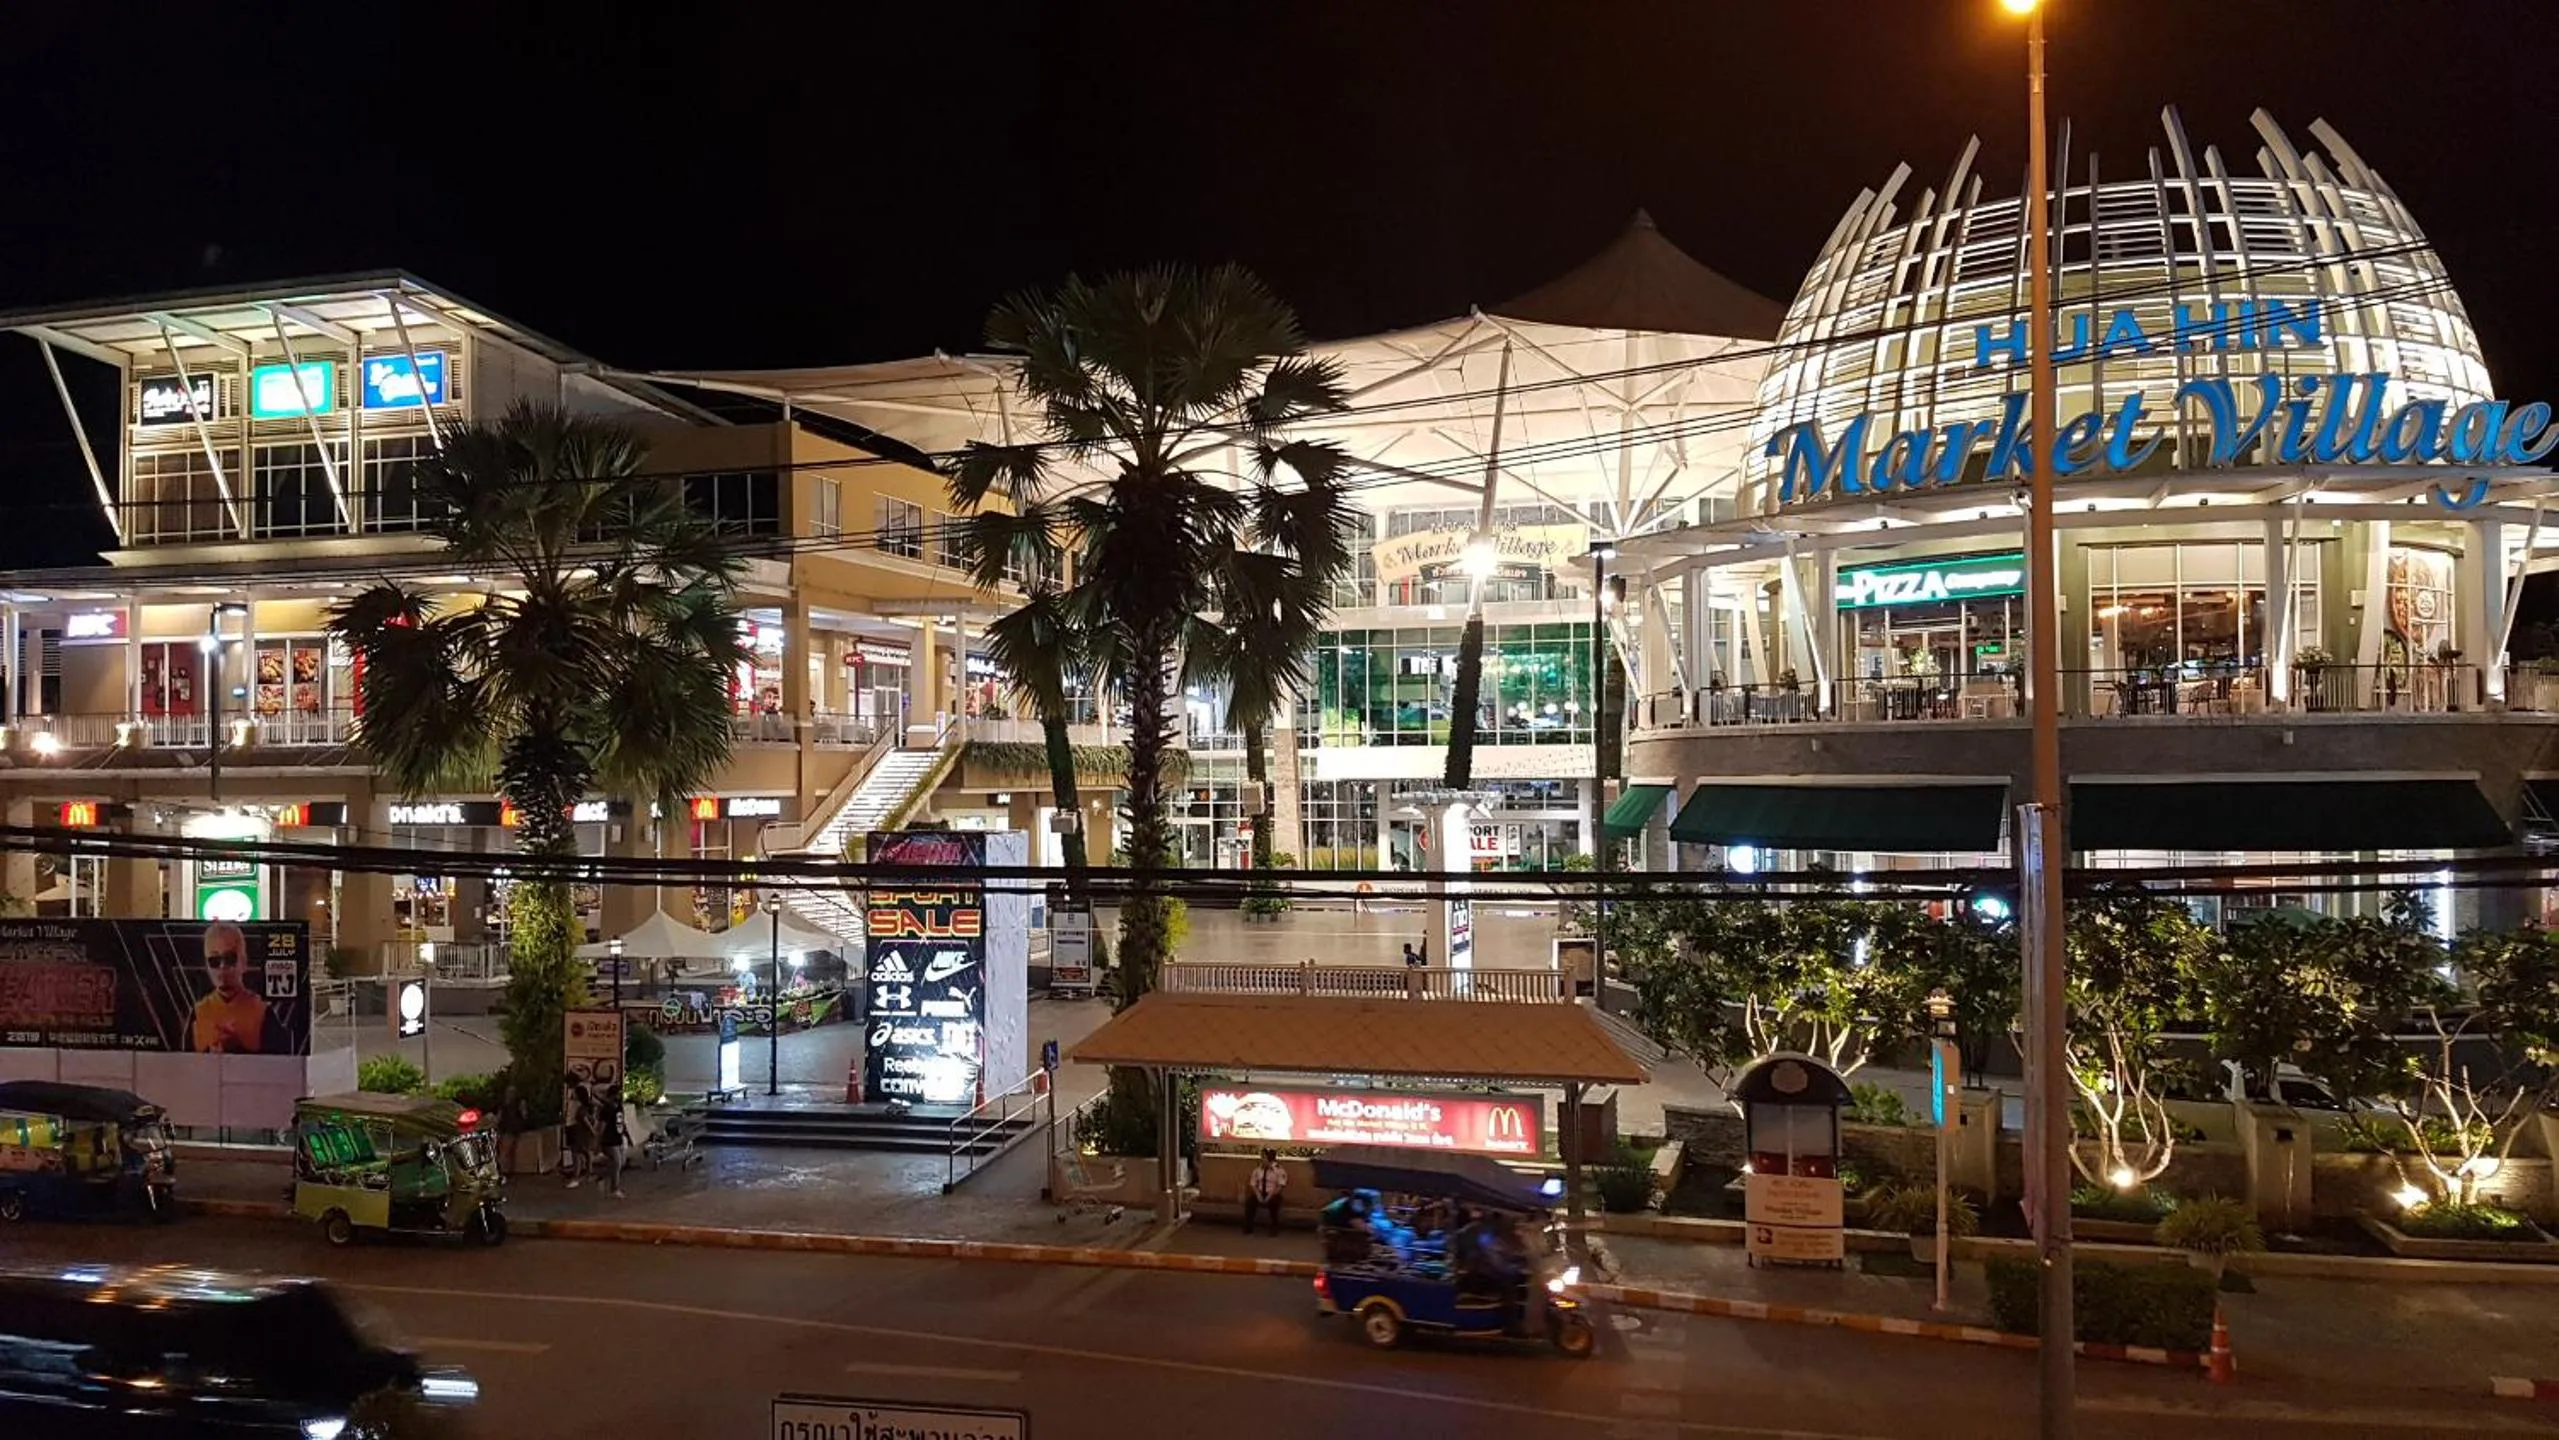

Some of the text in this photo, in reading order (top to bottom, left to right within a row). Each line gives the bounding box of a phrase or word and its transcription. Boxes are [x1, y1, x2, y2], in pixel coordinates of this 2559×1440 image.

[1974, 297, 2327, 367] HUA HIN
[1765, 370, 2559, 511] Market Village
[1853, 570, 1949, 606] PIZZA
[868, 909, 981, 937] SALE
[268, 933, 297, 948] 28
[268, 949, 297, 957] JULY
[932, 951, 968, 968] NIKE
[267, 974, 295, 995] TJ
[871, 970, 915, 982] adidas
[1316, 1098, 1441, 1122] McDonald's
